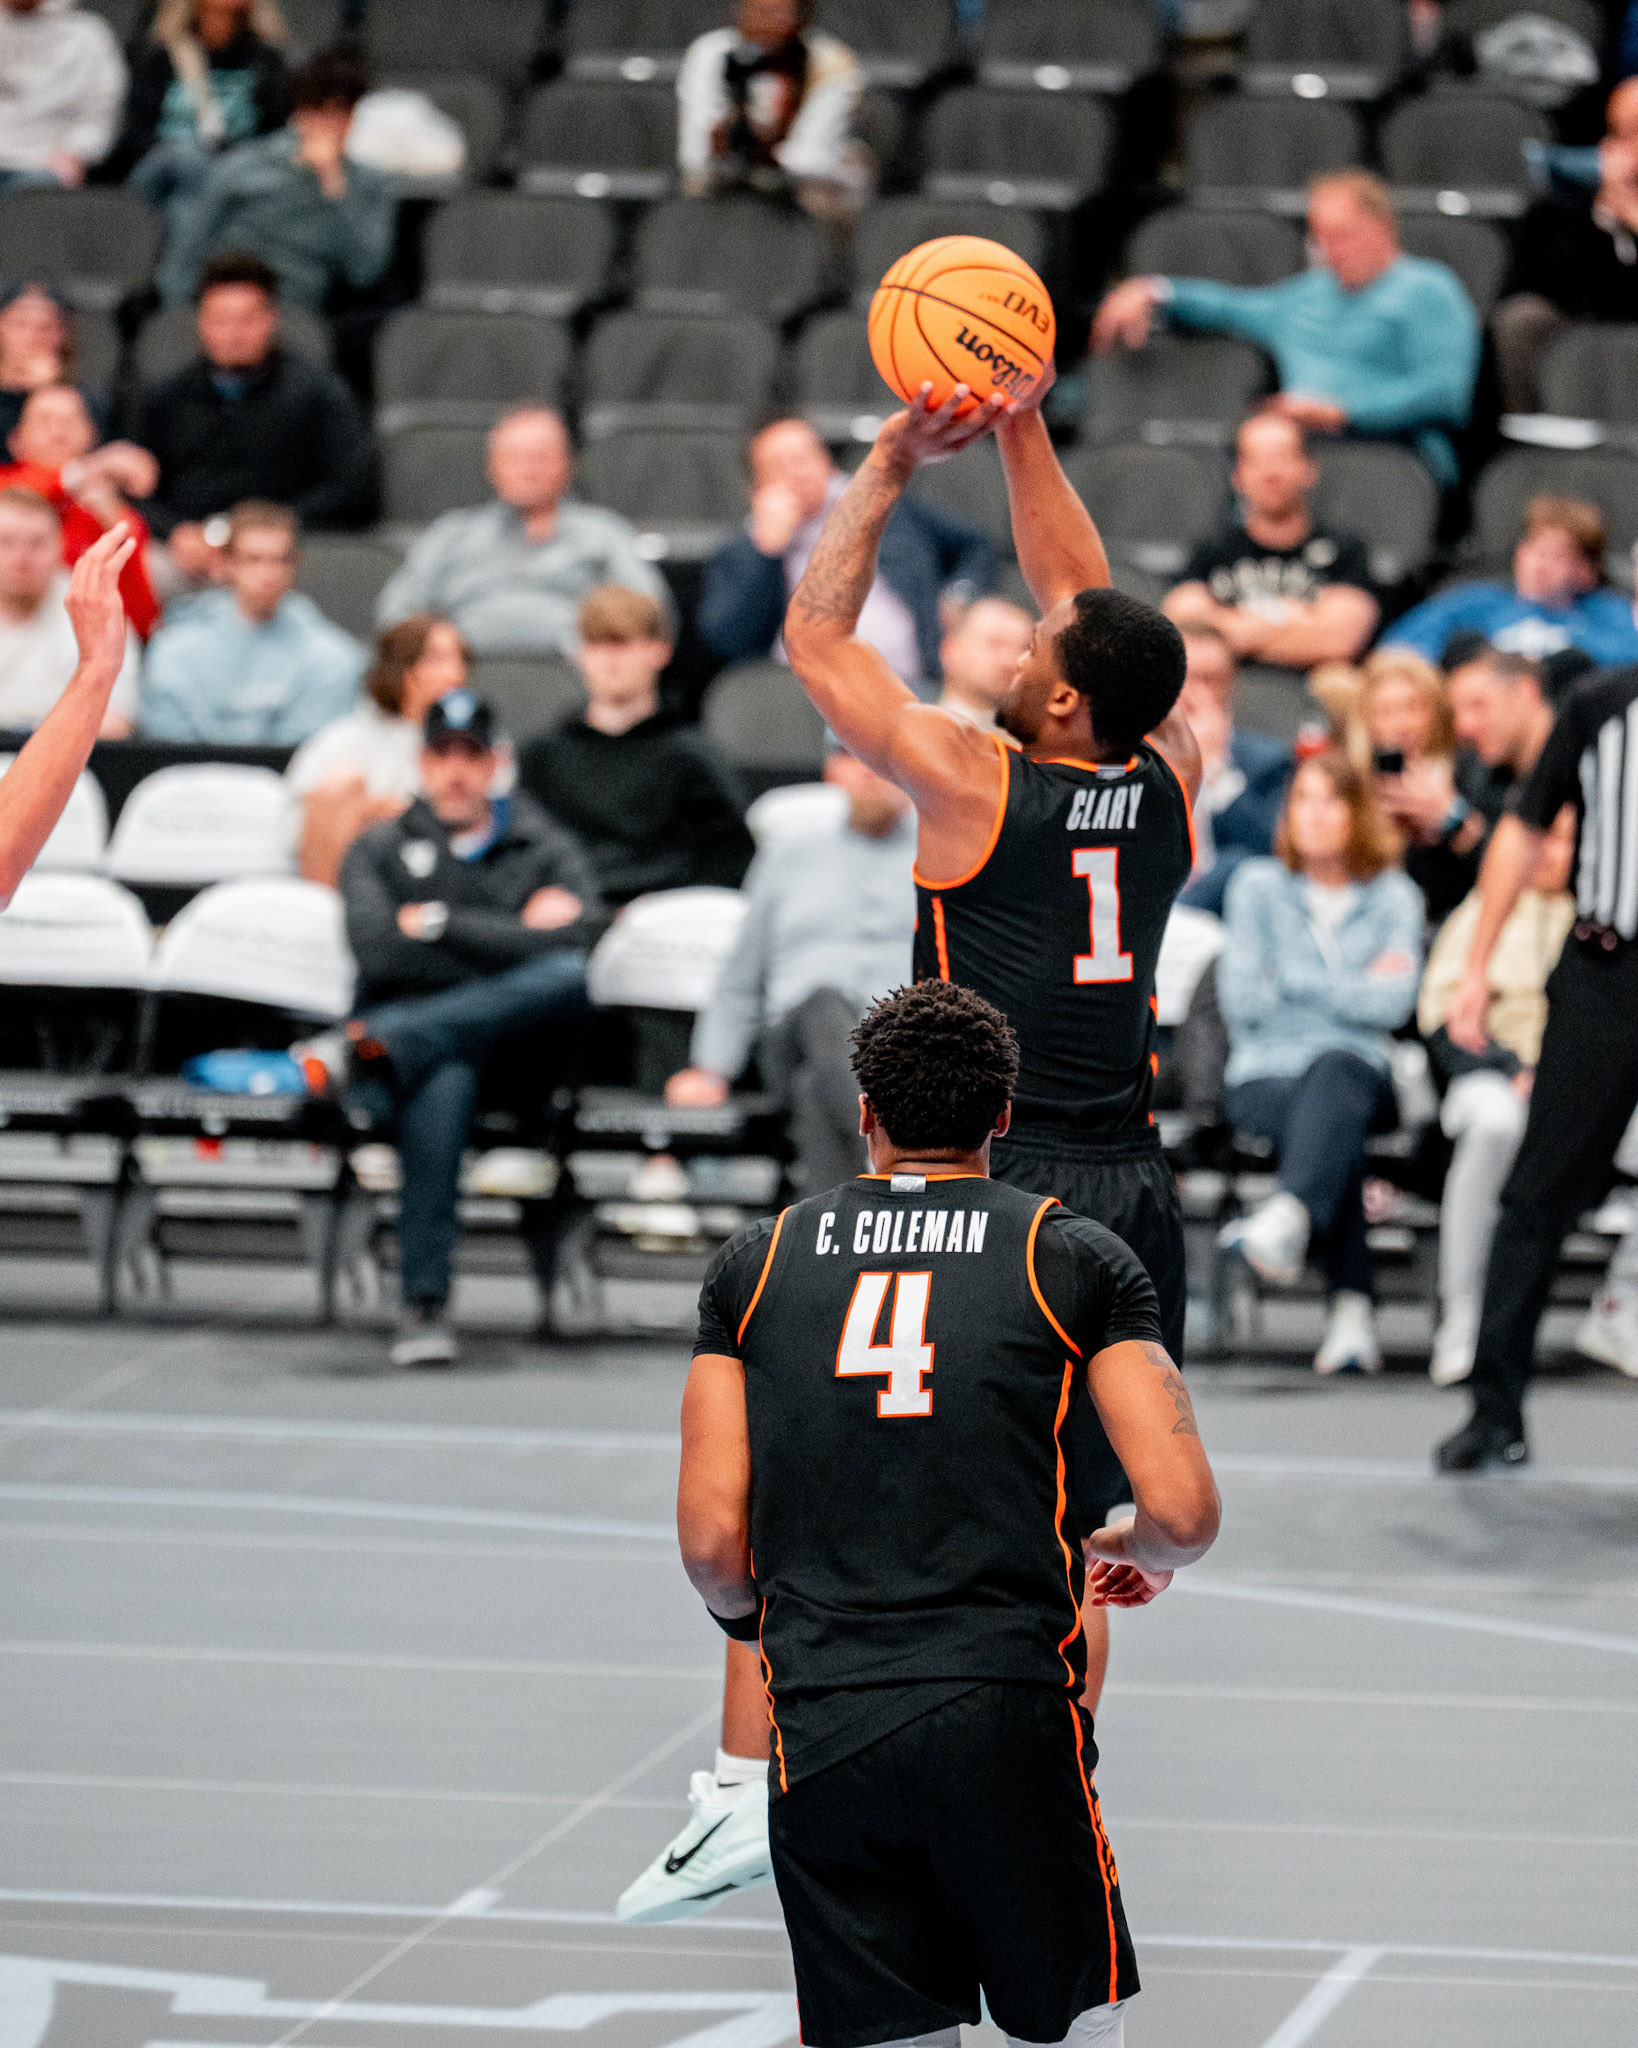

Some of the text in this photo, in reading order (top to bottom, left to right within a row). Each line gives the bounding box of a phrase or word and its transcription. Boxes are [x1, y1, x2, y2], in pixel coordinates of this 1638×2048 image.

[1065, 782, 1144, 831] CLARY
[1072, 847, 1133, 984] 1
[815, 1210, 989, 1255] C. COLEMAN
[834, 1271, 935, 1418] 4
